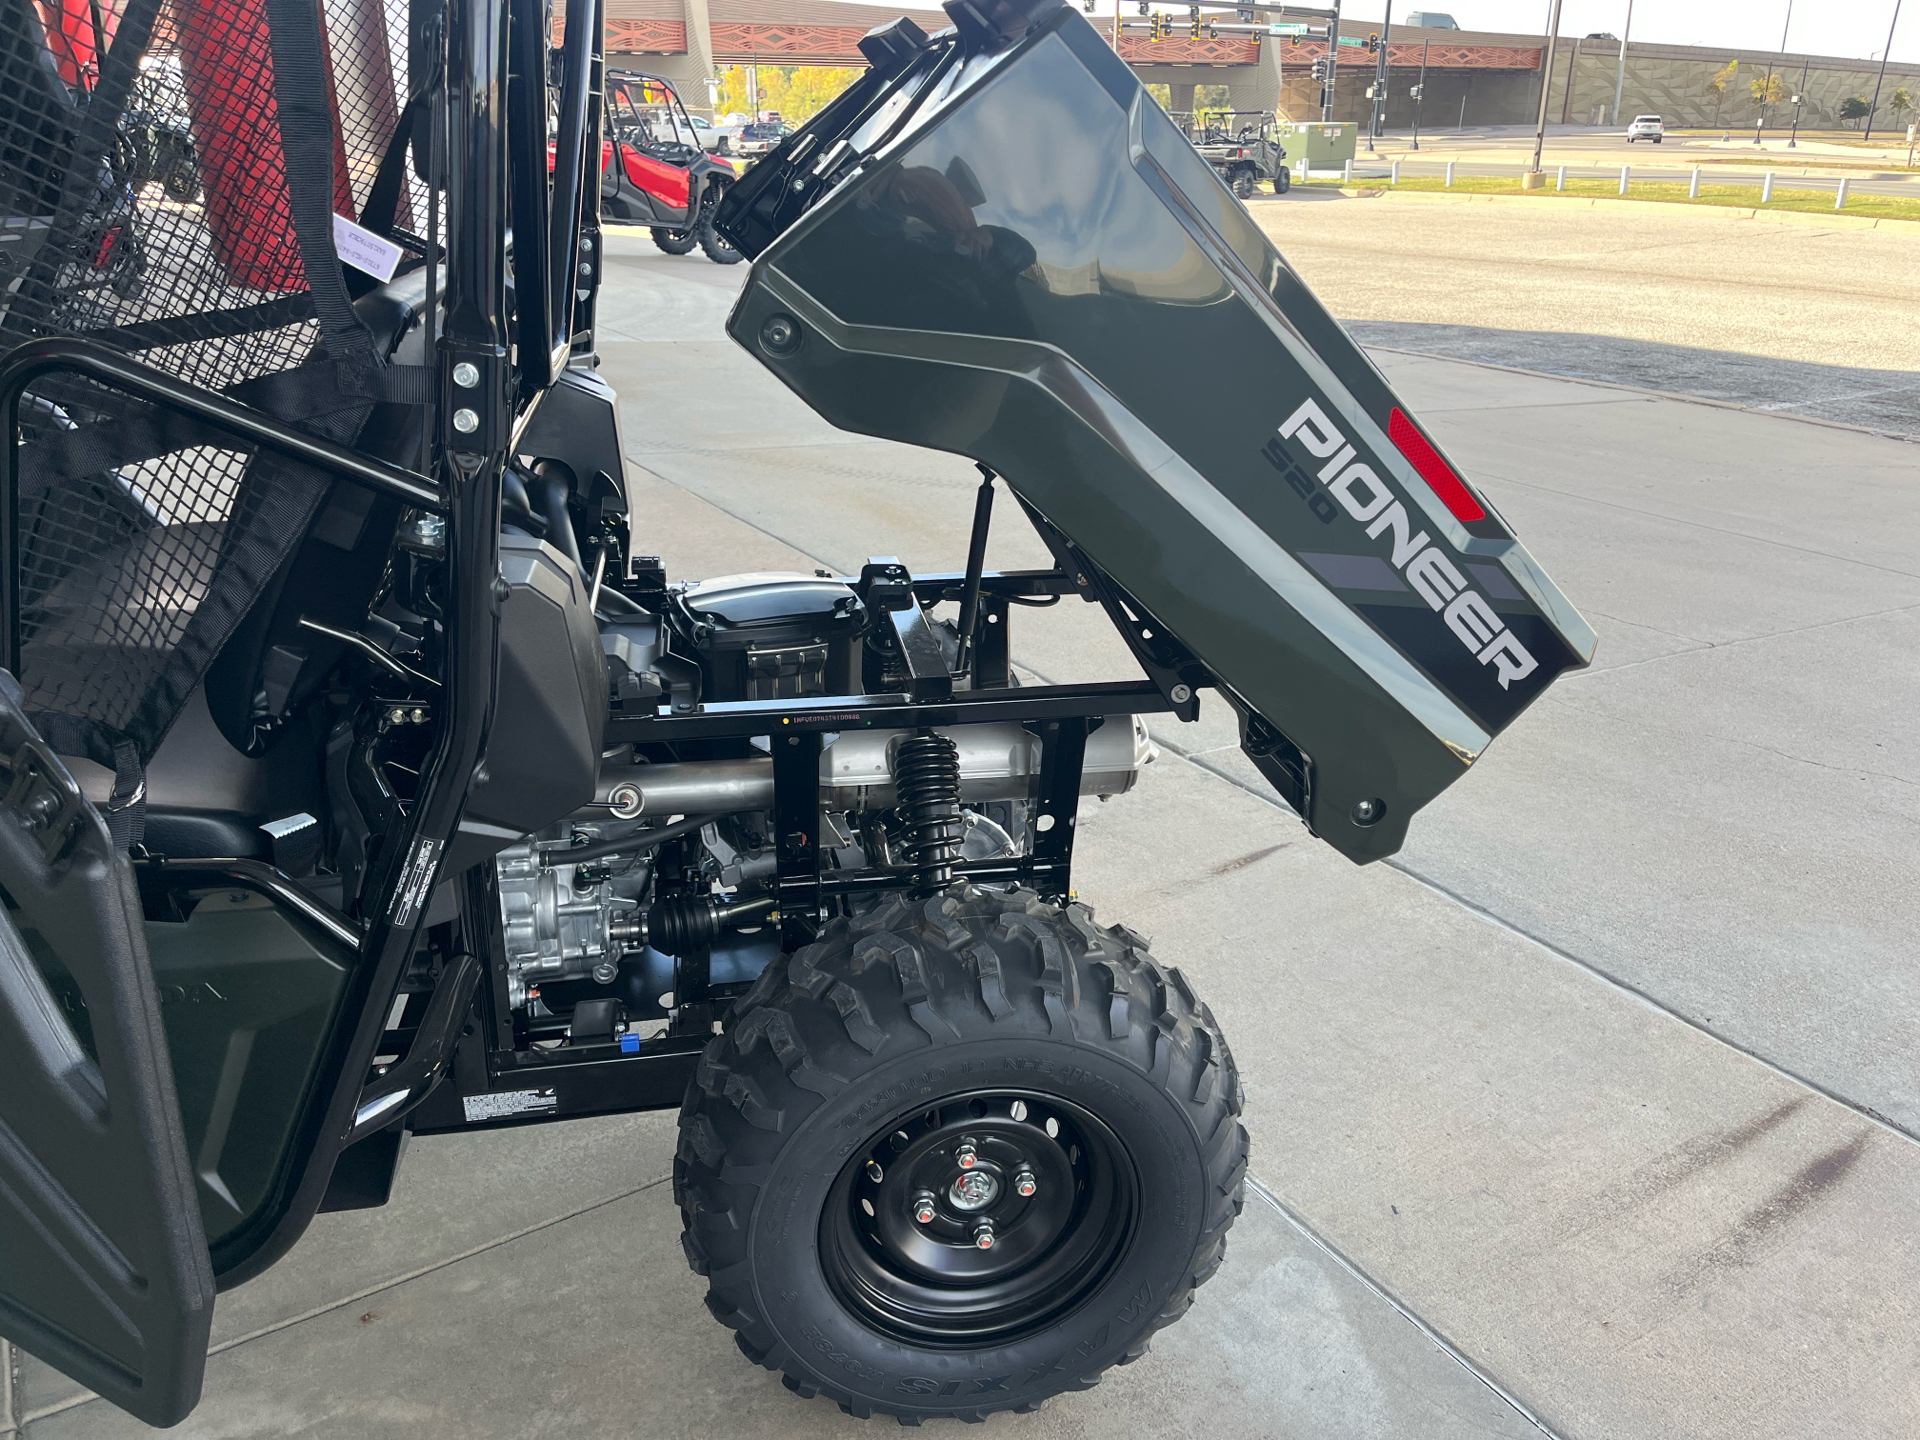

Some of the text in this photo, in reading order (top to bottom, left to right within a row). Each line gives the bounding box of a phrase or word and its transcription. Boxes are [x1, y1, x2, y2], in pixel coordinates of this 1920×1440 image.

[1260, 437, 1338, 525] 520
[1278, 397, 1539, 691] PIONEER
[895, 1280, 1154, 1398] MAXXIS
